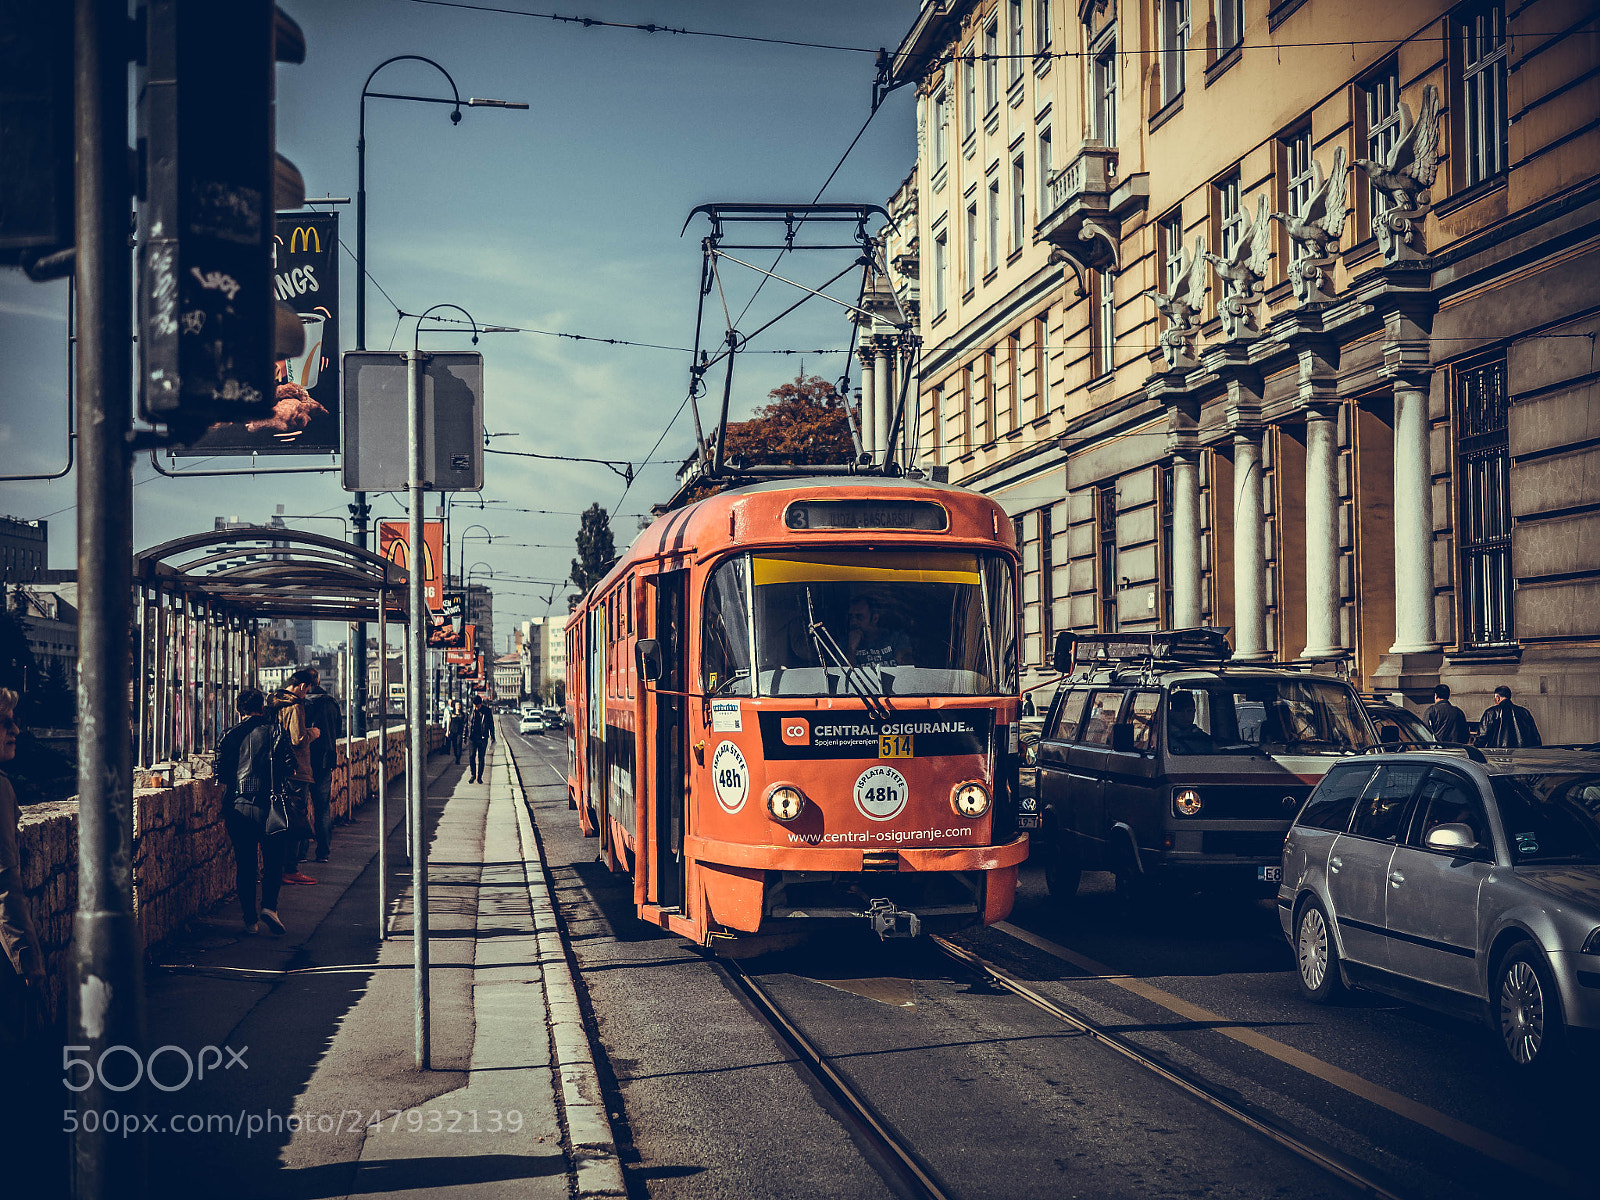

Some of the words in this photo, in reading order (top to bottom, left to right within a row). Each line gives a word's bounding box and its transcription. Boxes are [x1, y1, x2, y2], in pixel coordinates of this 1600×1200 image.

[793, 509, 805, 528] 3
[786, 725, 805, 738] CO
[814, 725, 879, 736] CENTRAL
[881, 722, 965, 735] OSIGURANJE
[814, 739, 839, 747] Spojeni
[839, 738, 879, 747] povjerenjem
[882, 736, 911, 756] 514
[714, 744, 730, 770] ISPLATA
[730, 744, 746, 771] ŠTETE
[719, 768, 741, 788] 48h
[857, 768, 885, 789] ISPLATA
[886, 767, 905, 788] ŠTETE
[865, 786, 898, 802] 48h
[787, 827, 972, 844] www.central-osiguranje.com
